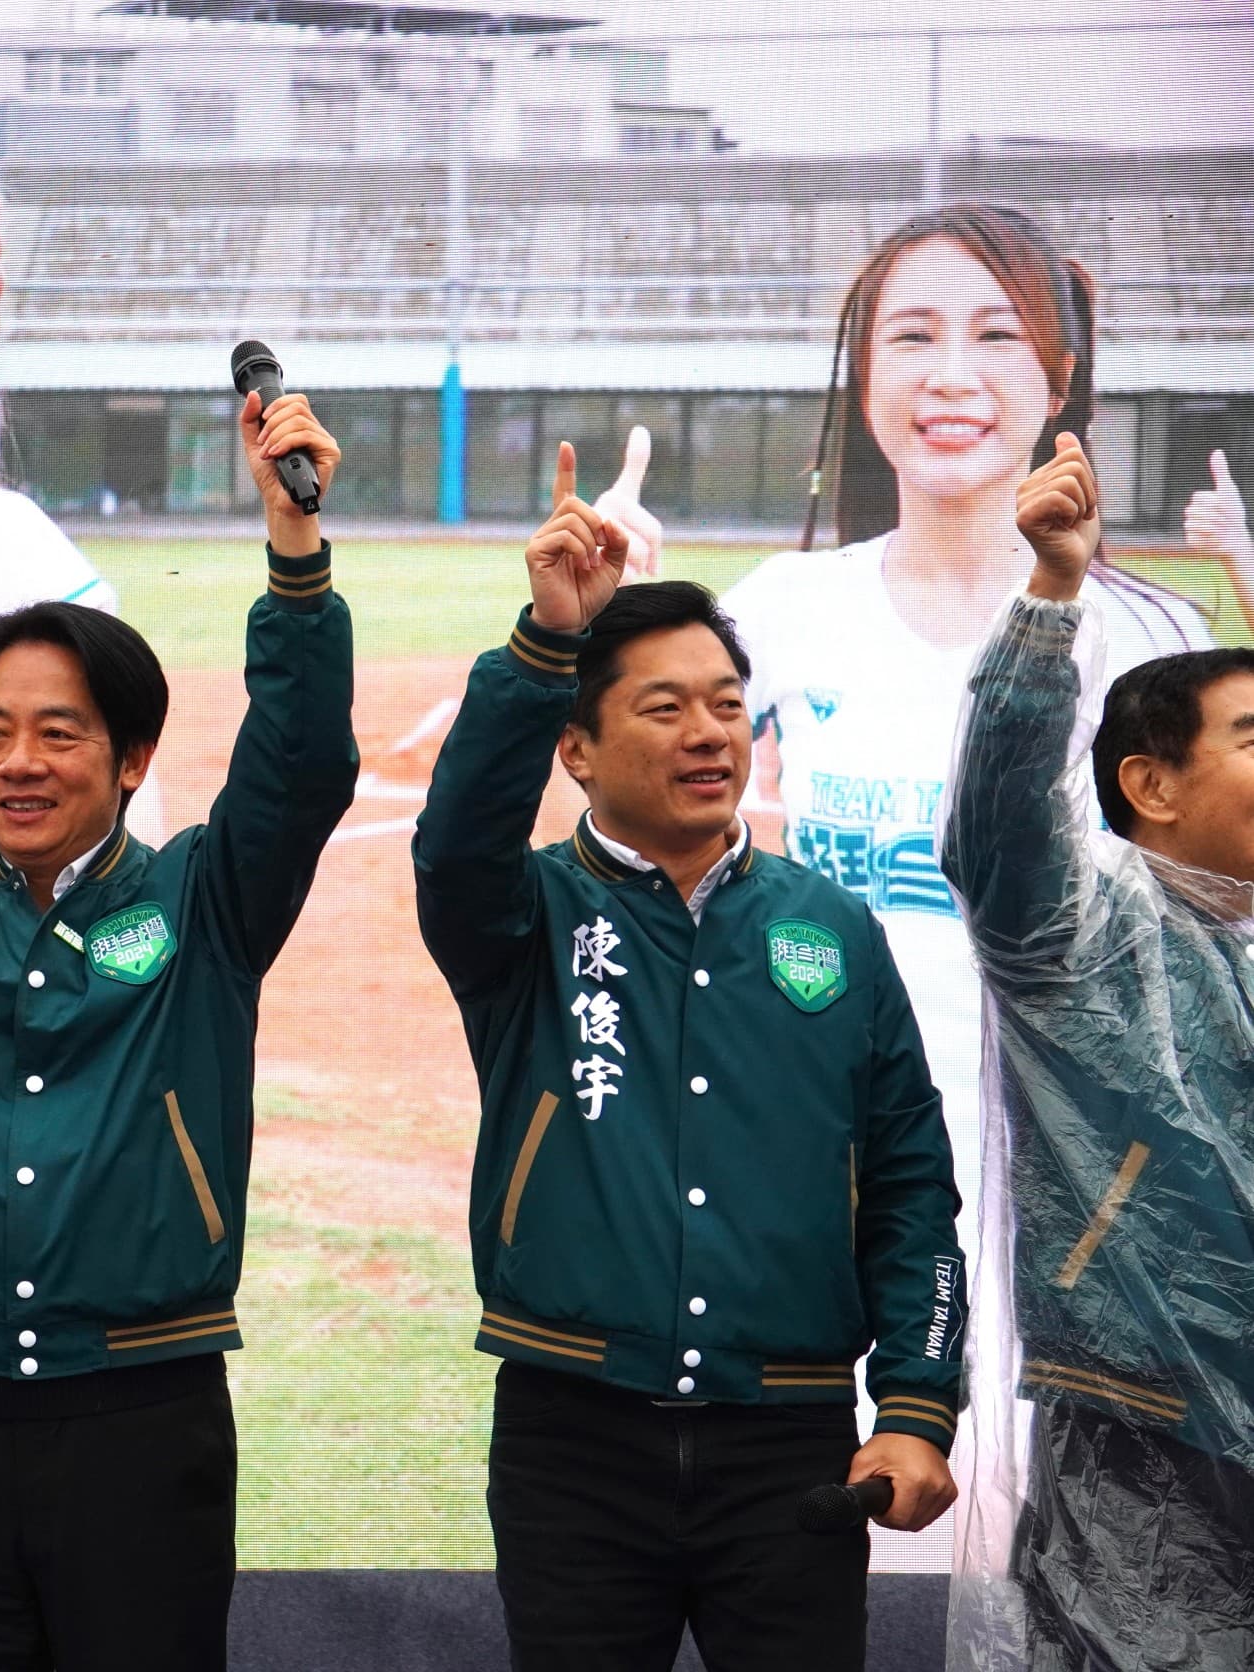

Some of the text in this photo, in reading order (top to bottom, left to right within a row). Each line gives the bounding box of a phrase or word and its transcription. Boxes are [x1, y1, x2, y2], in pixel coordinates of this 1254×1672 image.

[811, 771, 909, 823] TEAM
[91, 914, 168, 963] 挺台灣
[115, 942, 154, 965] 2024
[771, 937, 841, 976] 挺台灣
[789, 963, 824, 984] 2024
[570, 915, 628, 1121] 陳俊宇
[925, 1262, 951, 1360] TEAM TAIWAN
